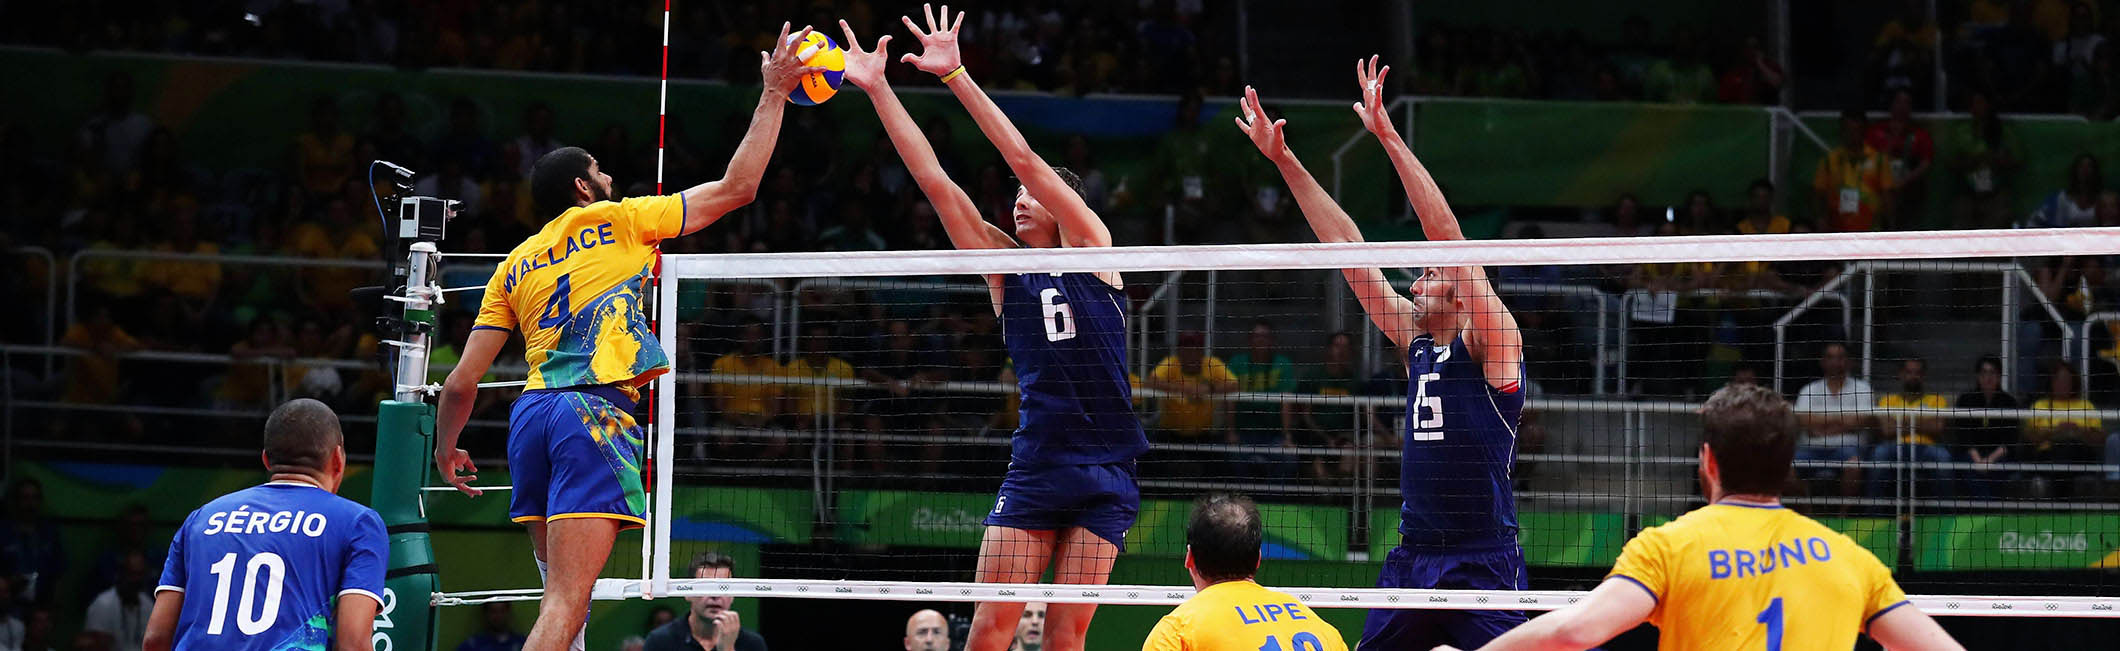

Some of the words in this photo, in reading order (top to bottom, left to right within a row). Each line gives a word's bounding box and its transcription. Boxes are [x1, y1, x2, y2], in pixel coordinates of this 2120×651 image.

[504, 222, 616, 294] WALLACE
[538, 273, 573, 334] 4
[1040, 287, 1077, 342] 6
[203, 505, 327, 537] SÉRGIO
[994, 496, 1007, 514] 6
[1708, 537, 1831, 580] BRUNO
[207, 552, 286, 636] 10
[1234, 603, 1308, 625] LIPE
[1756, 597, 1784, 651] 1
